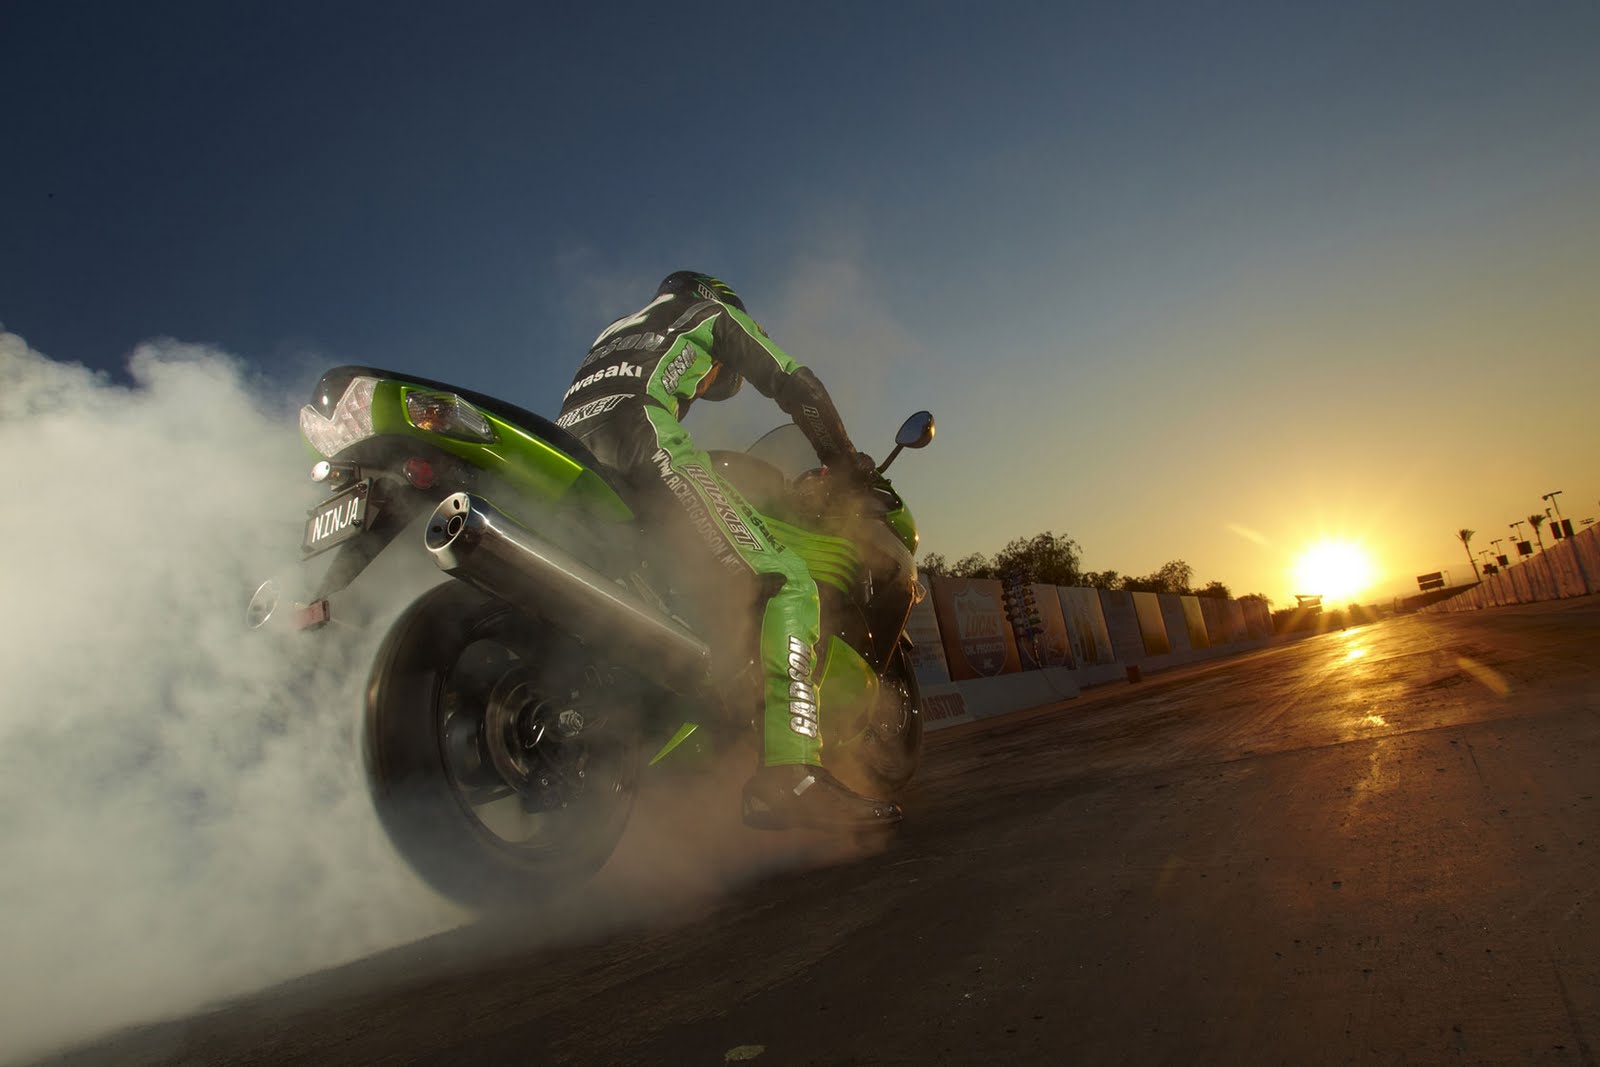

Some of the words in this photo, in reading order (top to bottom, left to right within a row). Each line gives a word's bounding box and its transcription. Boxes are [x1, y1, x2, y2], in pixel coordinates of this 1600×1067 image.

[563, 361, 642, 402] wasaki
[312, 497, 359, 543] NINJA
[788, 635, 818, 738] GADSON
